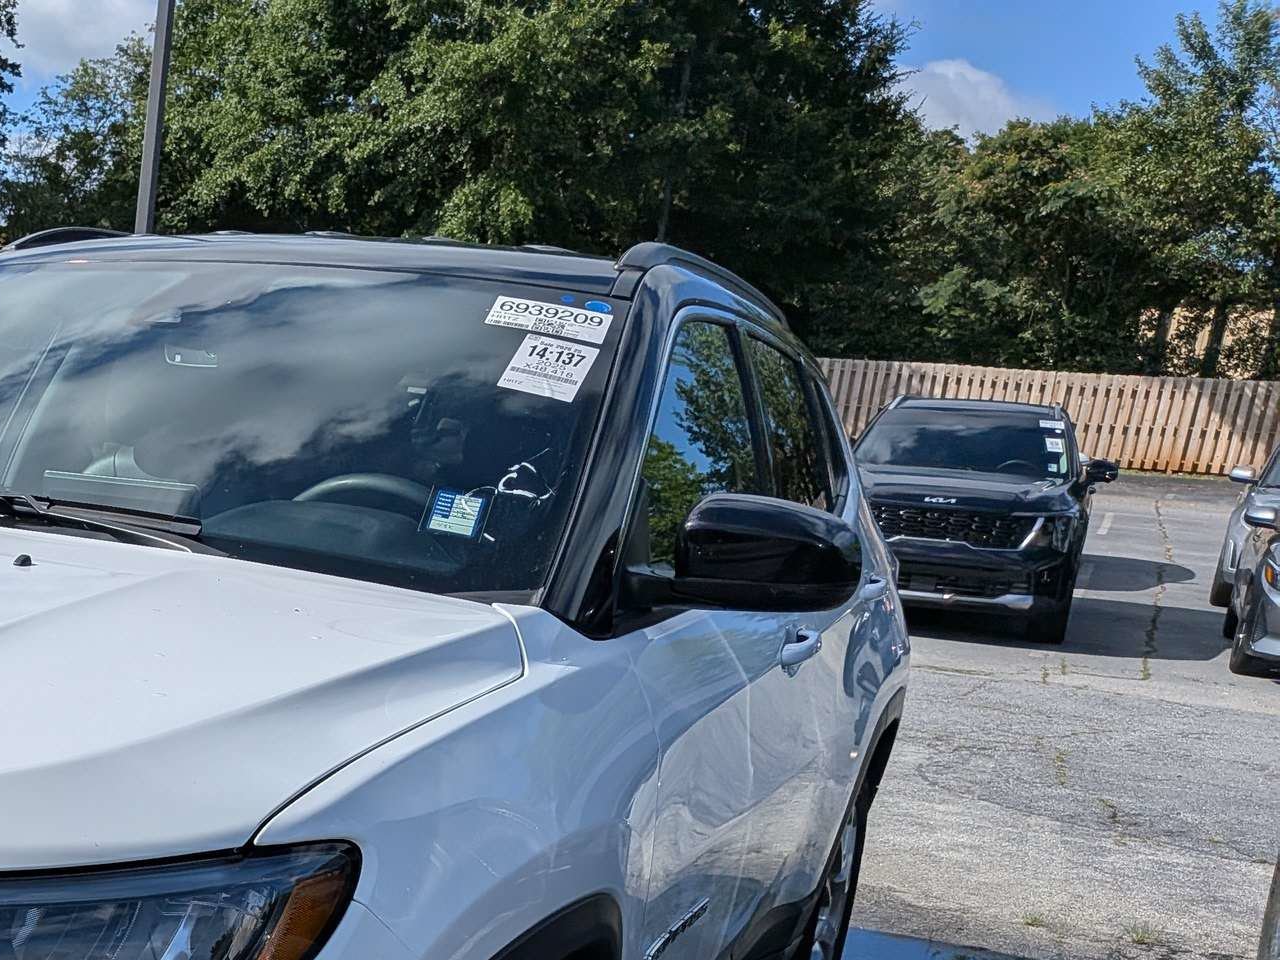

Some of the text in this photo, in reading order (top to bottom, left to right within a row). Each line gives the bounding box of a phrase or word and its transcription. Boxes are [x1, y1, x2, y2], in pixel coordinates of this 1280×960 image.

[499, 300, 604, 327] 6939209
[528, 344, 587, 368] 14:137
[536, 359, 567, 371] 2025
